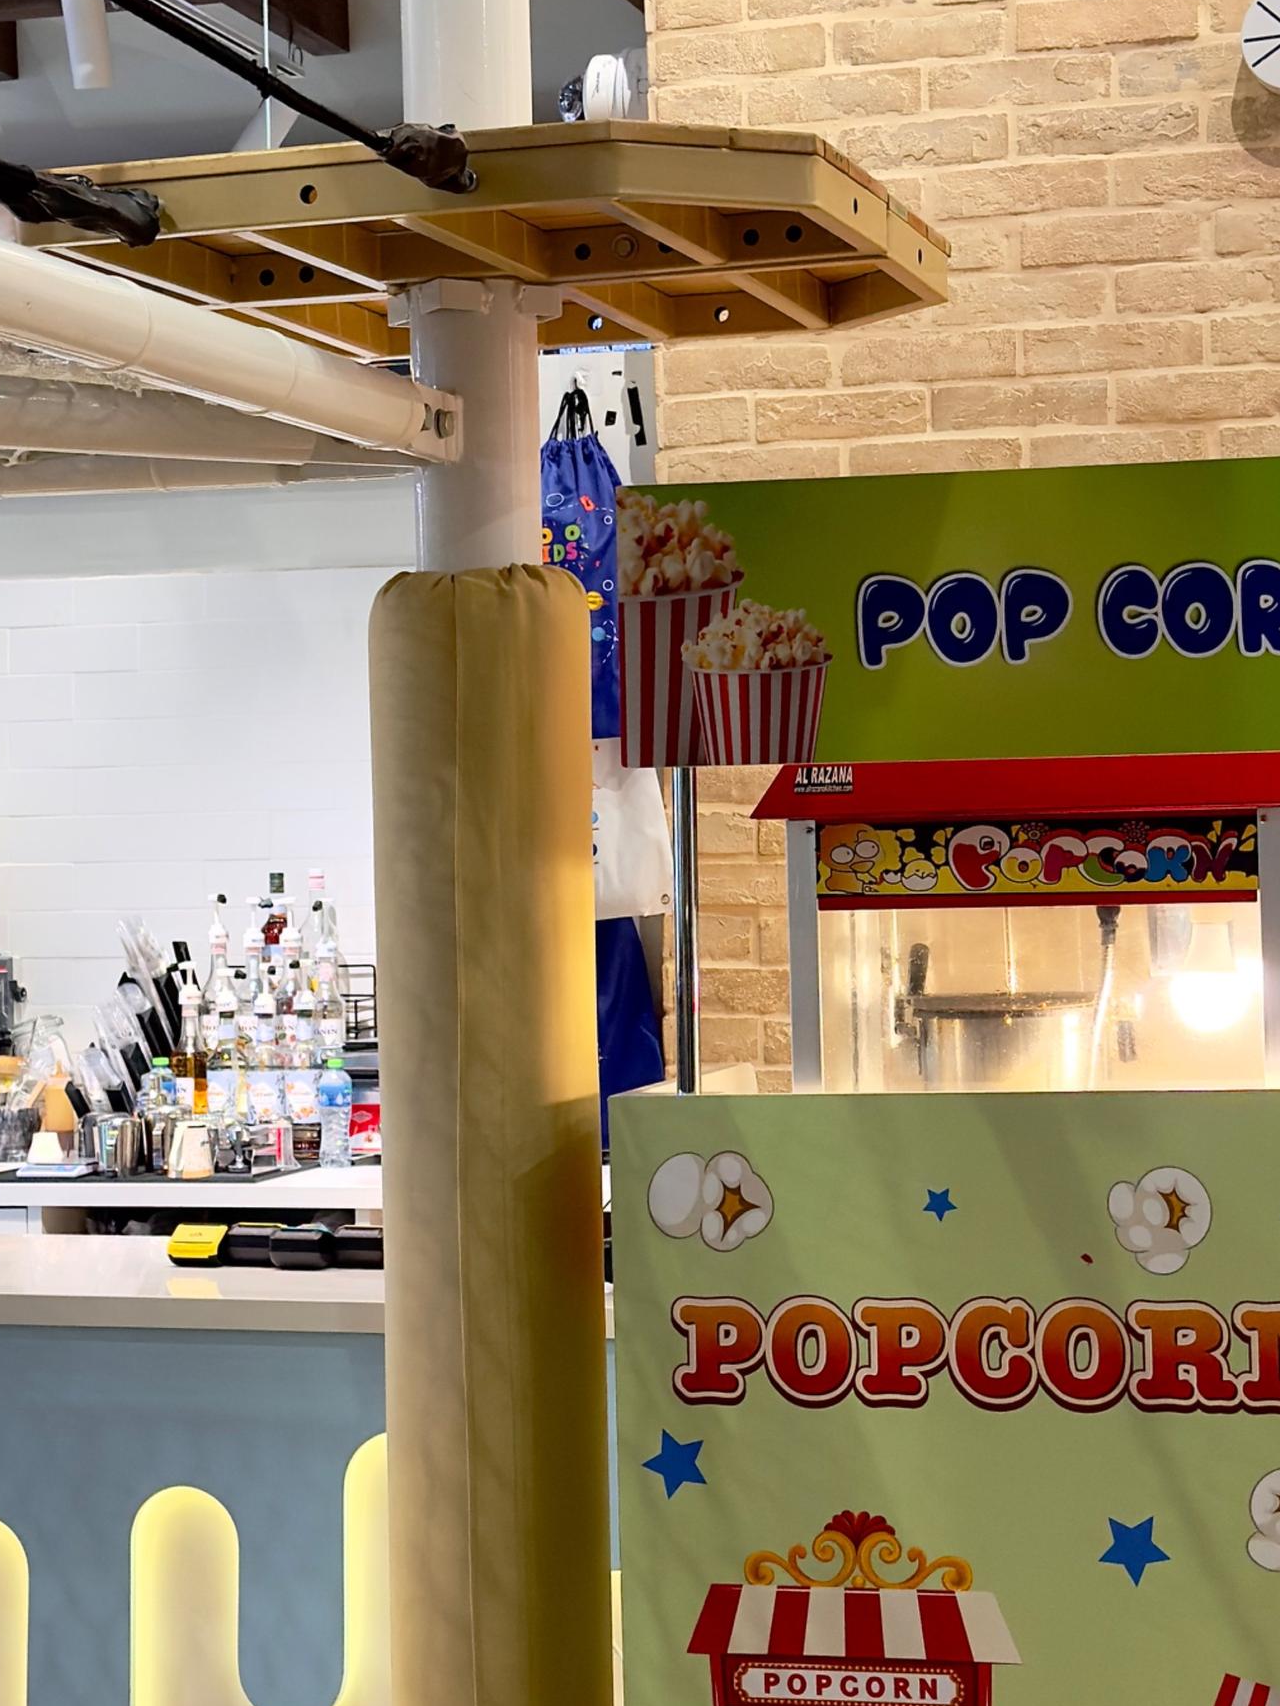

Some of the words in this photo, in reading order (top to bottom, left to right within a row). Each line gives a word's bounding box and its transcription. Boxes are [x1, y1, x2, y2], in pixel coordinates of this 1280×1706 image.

[542, 541, 578, 563] IDS
[856, 567, 1074, 671] POP
[794, 767, 809, 784] AL
[810, 765, 853, 784] RAZANA
[761, 1670, 942, 1703] POPCORN
